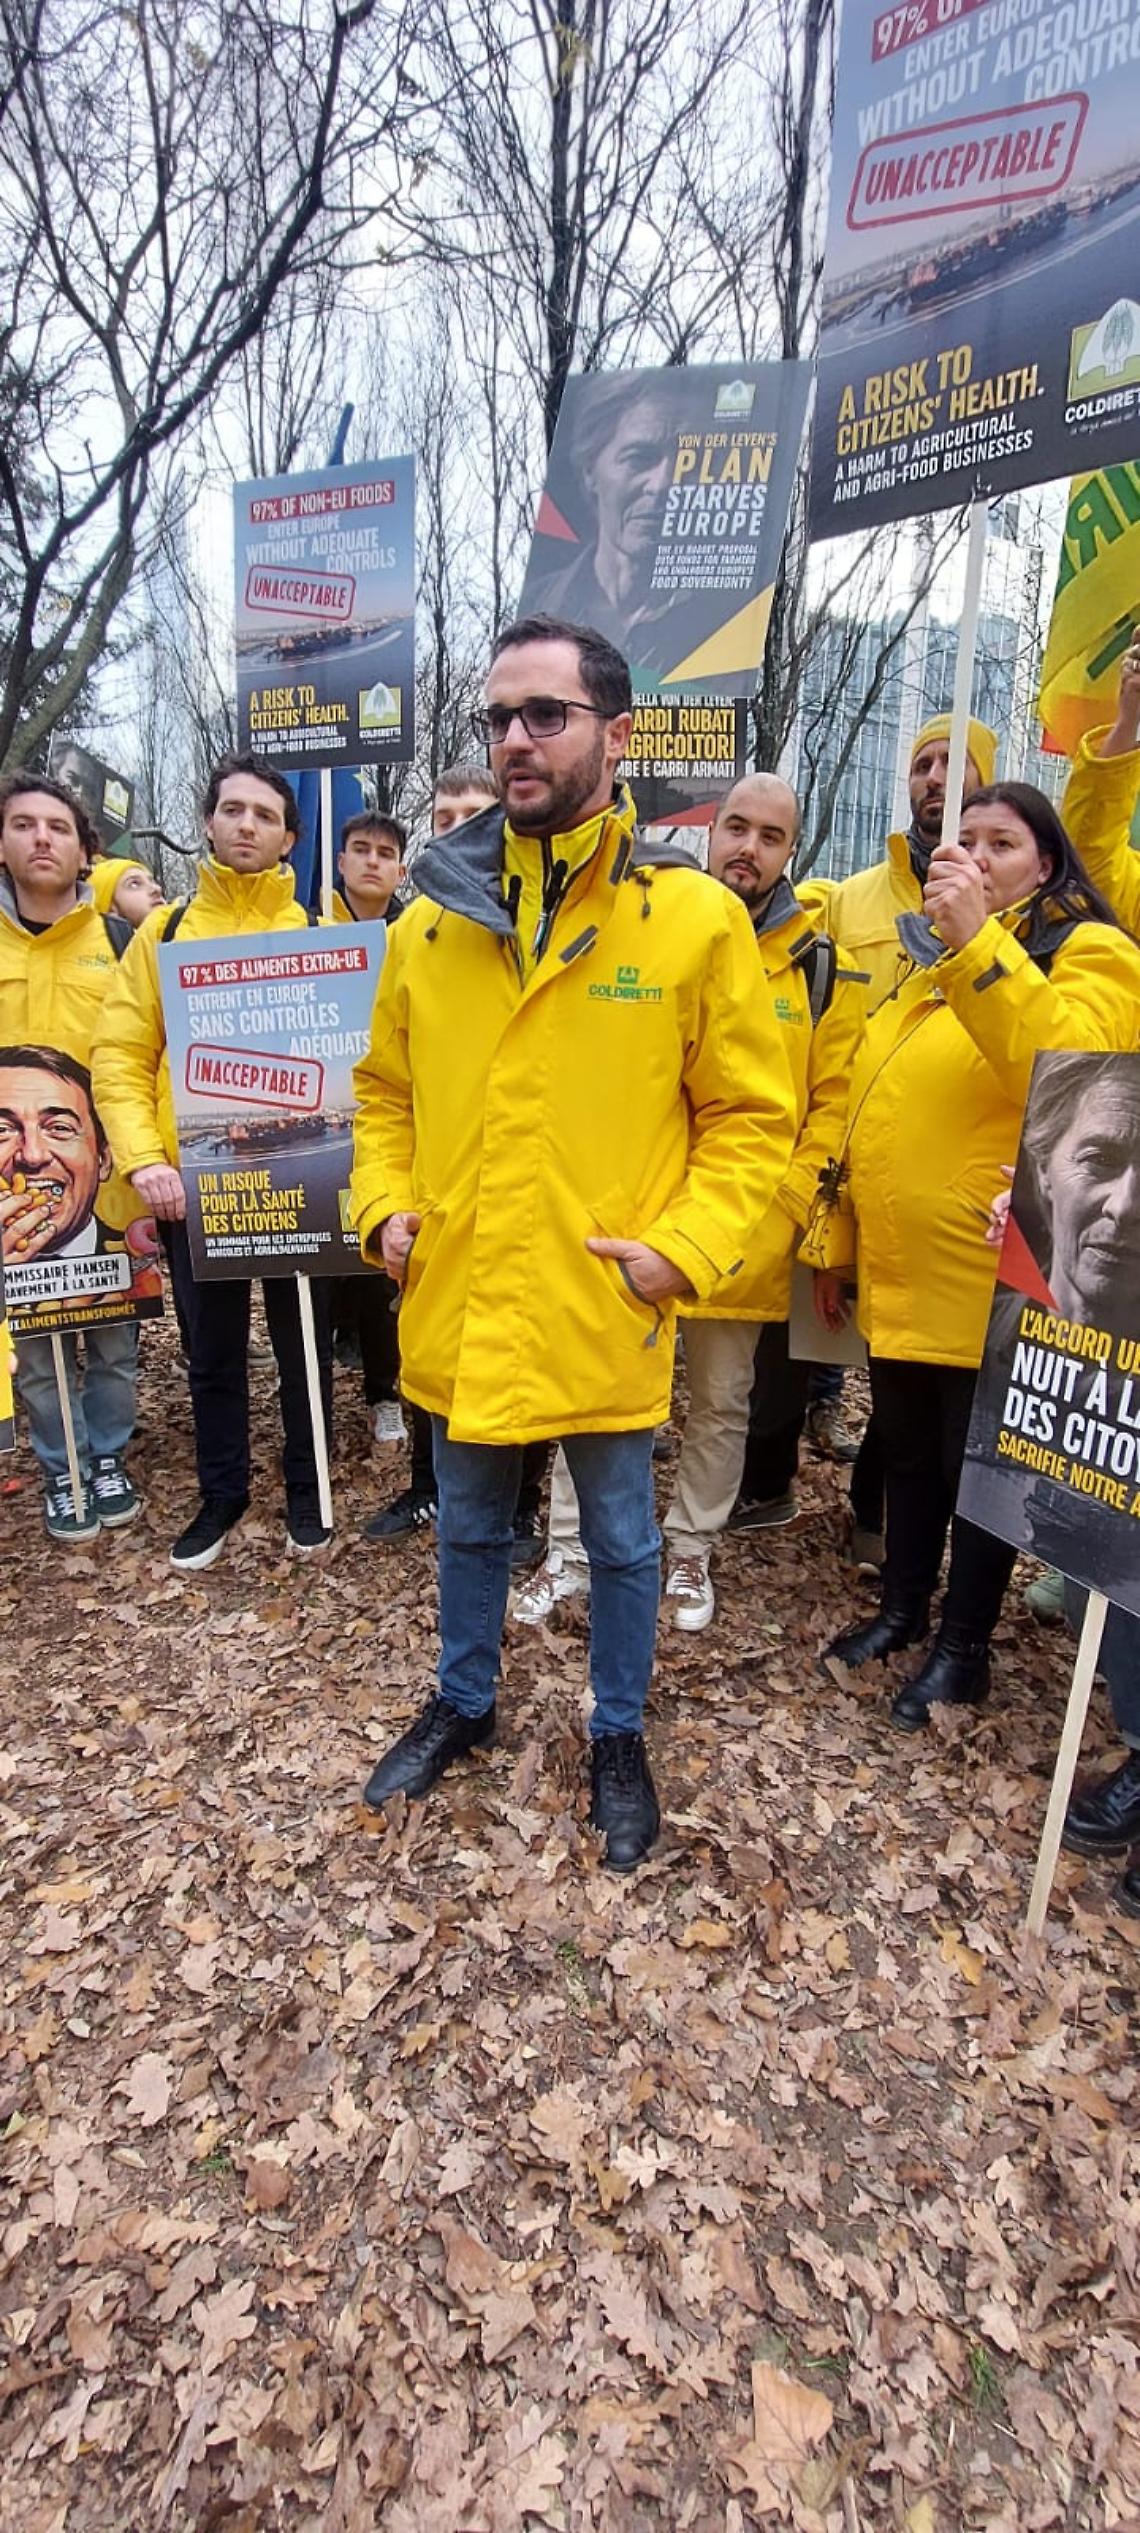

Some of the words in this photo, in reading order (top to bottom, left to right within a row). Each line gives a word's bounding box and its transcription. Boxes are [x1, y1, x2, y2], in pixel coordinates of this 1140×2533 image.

[878, 0, 928, 54] 97%
[904, 21, 970, 80] ENTER
[858, 48, 986, 147] WITHOUT
[865, 121, 1066, 205] UNACCEPTABLE
[838, 383, 856, 424] A
[864, 358, 930, 415] RISK
[937, 344, 973, 390] TO
[836, 397, 942, 456] CITIZENS'
[949, 363, 1044, 422] HEALTH.
[678, 434, 700, 447] VON
[705, 433, 727, 447] DER
[731, 432, 778, 447] LEYEN'S
[835, 462, 844, 482] A
[848, 451, 886, 478] HARM
[890, 445, 907, 464] TO
[911, 412, 1016, 459] AGRICULTURAL
[672, 448, 774, 484] PLAN
[833, 480, 861, 504] AND
[863, 459, 939, 496] AGRI-FOOD
[943, 429, 1034, 472] BUSINESSES
[252, 501, 277, 521] 97%
[281, 499, 298, 517] OF
[300, 491, 347, 515] NON-EU
[350, 482, 391, 506] FOODS
[666, 485, 768, 511] STARVES
[267, 519, 299, 540] ENTER
[301, 514, 341, 535] EUROPE
[661, 511, 763, 537] EUROPE
[245, 537, 307, 565] WITHOUT
[311, 527, 379, 557] ADEQUATE
[325, 547, 397, 574] CONTROLS
[254, 575, 347, 609] UNACCEPTABLE
[650, 576, 679, 589] FOOD
[250, 691, 259, 712] A
[263, 687, 295, 710] RISK
[298, 685, 315, 706] TO
[250, 708, 302, 730] CITIZENS'
[305, 703, 350, 725] HEALTH.
[679, 709, 735, 732] RUBATI
[643, 760, 650, 777] E
[653, 761, 688, 777] CARRI
[691, 761, 735, 778] ARMATI
[183, 968, 198, 985] 97
[201, 967, 213, 983] %
[215, 964, 238, 982] DES
[241, 956, 298, 980] ALIMENTS
[302, 949, 361, 971] EXTRA-UE
[187, 989, 242, 1013] ENTRENT
[247, 987, 263, 1006] EN
[267, 983, 317, 1004] EUROPE
[589, 984, 662, 1000] COLDIRETTI
[189, 1013, 235, 1040] SANS
[289, 1029, 372, 1060] ADÉQUATS
[195, 1057, 308, 1097] INACCEPTABLE
[199, 1173, 218, 1193] UN
[222, 1170, 271, 1193] RISQUE
[201, 1194, 238, 1213] POUR
[243, 1192, 259, 1211] LA
[262, 1184, 306, 1210] SANTÉ
[203, 1214, 229, 1234] DES
[232, 1211, 298, 1232] CITOYENS
[73, 1277, 85, 1289] LA
[89, 1273, 120, 1288] SANTÉ
[74, 1258, 120, 1277] HANSEN
[1019, 1307, 1112, 1362] L'ACCORD
[1011, 1341, 1084, 1403] NUIT
[1085, 1356, 1108, 1416] À
[1002, 1387, 1057, 1443] DES
[998, 1430, 1067, 1480] SACRIFIE
[1069, 1462, 1127, 1509] NOTRE
